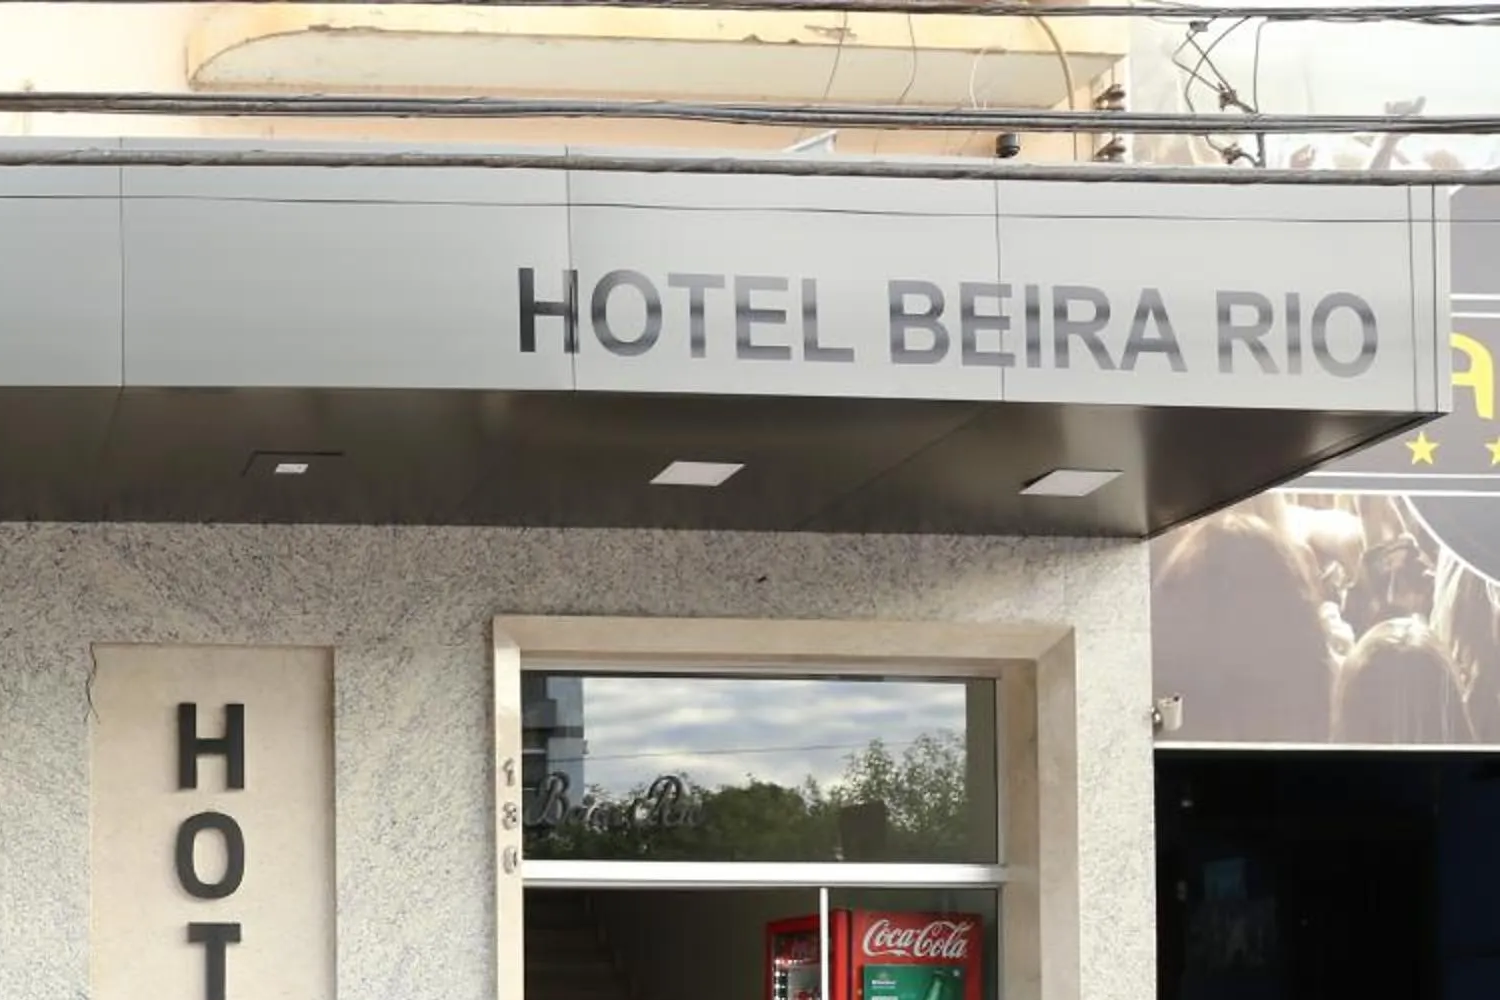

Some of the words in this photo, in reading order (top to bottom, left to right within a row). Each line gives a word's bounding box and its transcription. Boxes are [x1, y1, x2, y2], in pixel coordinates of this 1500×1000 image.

[518, 267, 855, 362] HOTEL
[888, 280, 1188, 372] BEIRA
[1215, 291, 1378, 378] RIO
[862, 919, 974, 958] Coca-Cola
